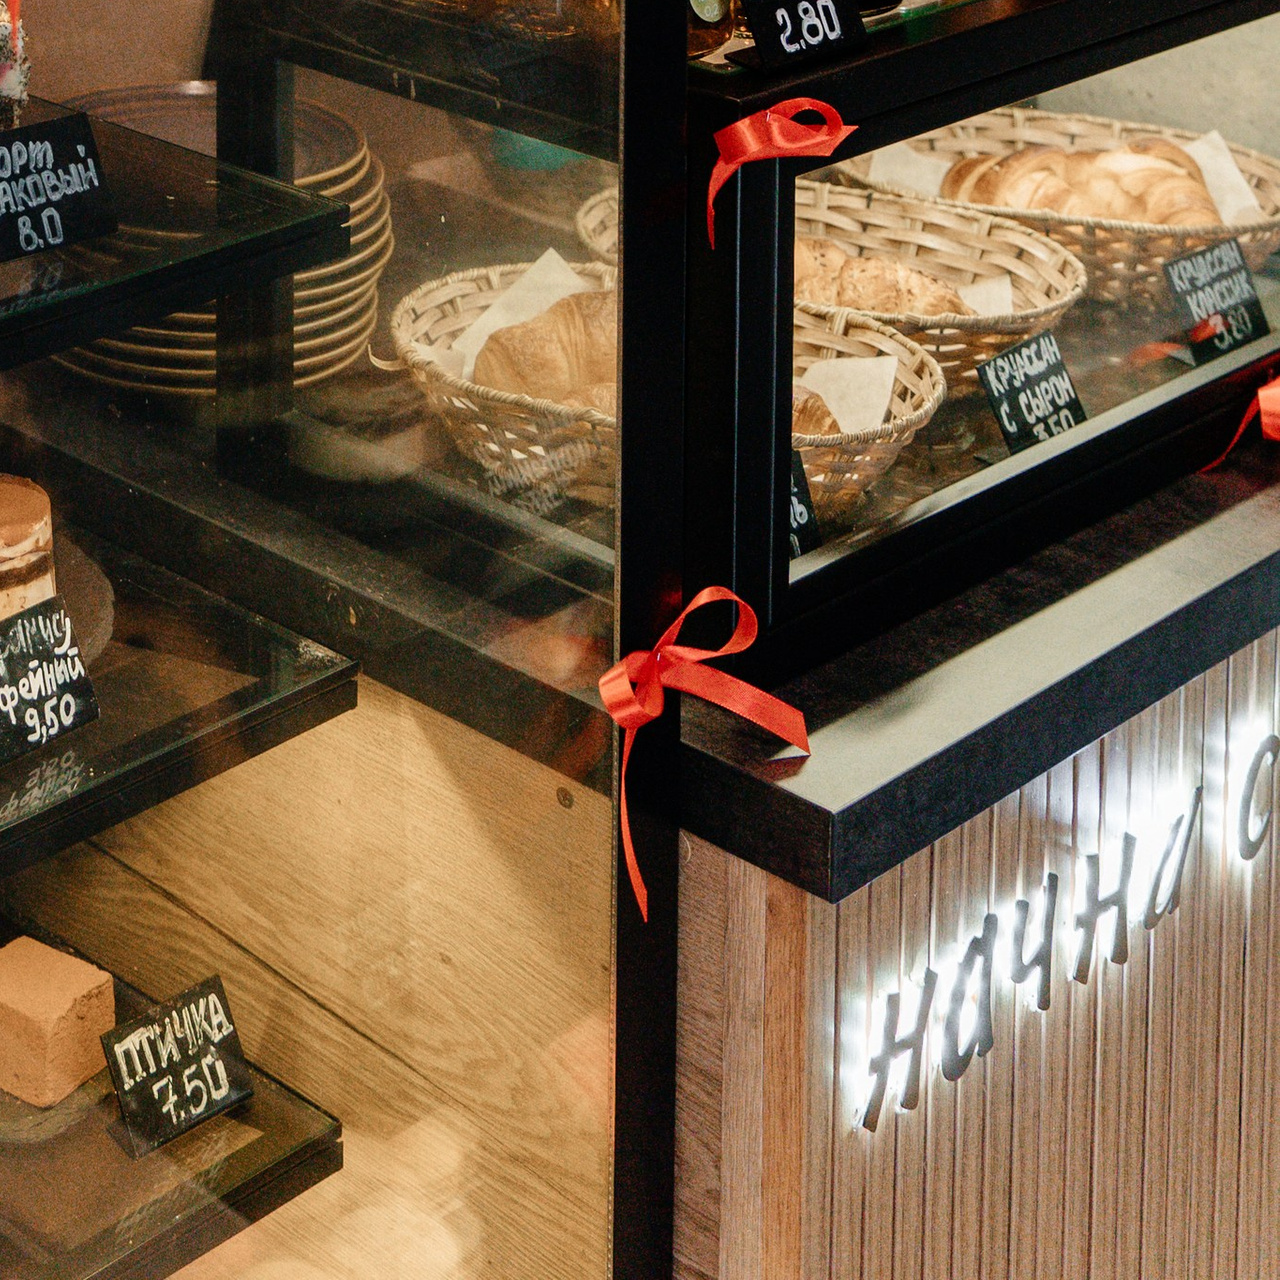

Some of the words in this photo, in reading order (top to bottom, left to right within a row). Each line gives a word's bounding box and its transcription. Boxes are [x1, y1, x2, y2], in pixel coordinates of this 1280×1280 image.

[985, 334, 1062, 398] КРУАССАН
[24, 693, 76, 744] 9,50
[114, 993, 234, 1091] ПТИЧКА
